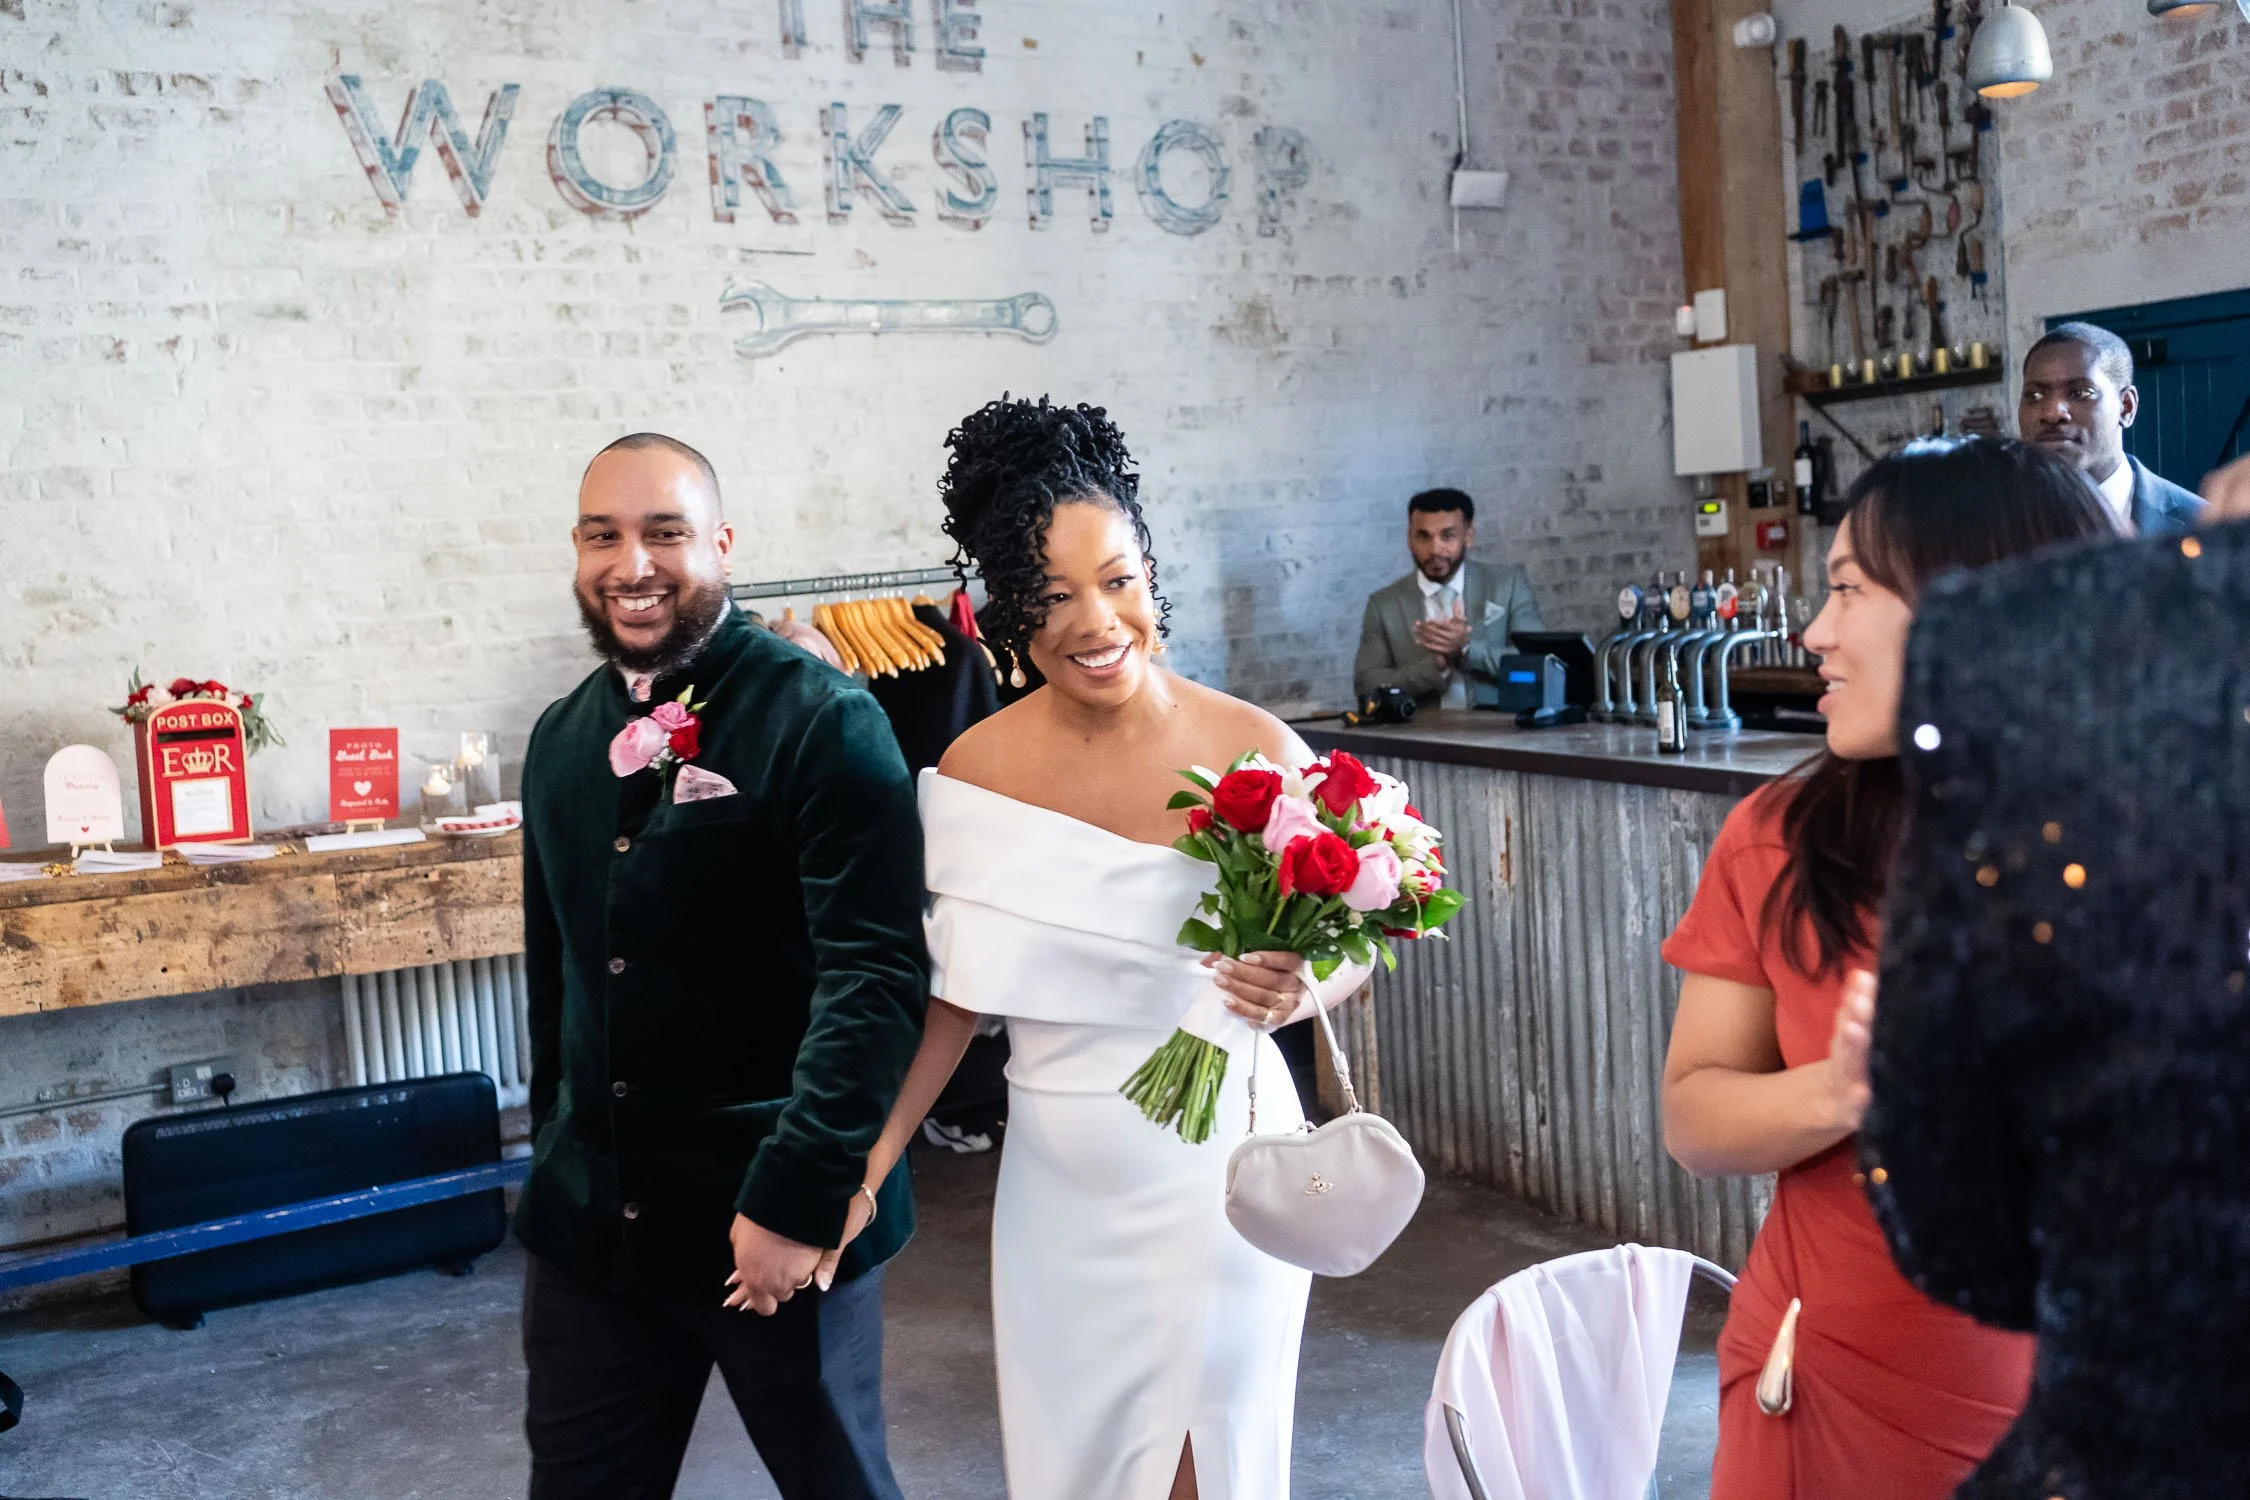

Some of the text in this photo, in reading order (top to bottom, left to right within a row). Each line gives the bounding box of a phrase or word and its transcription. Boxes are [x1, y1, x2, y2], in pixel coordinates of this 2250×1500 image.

[325, 72, 1312, 238] WORKSHOP
[157, 712, 234, 729] POST BOX
